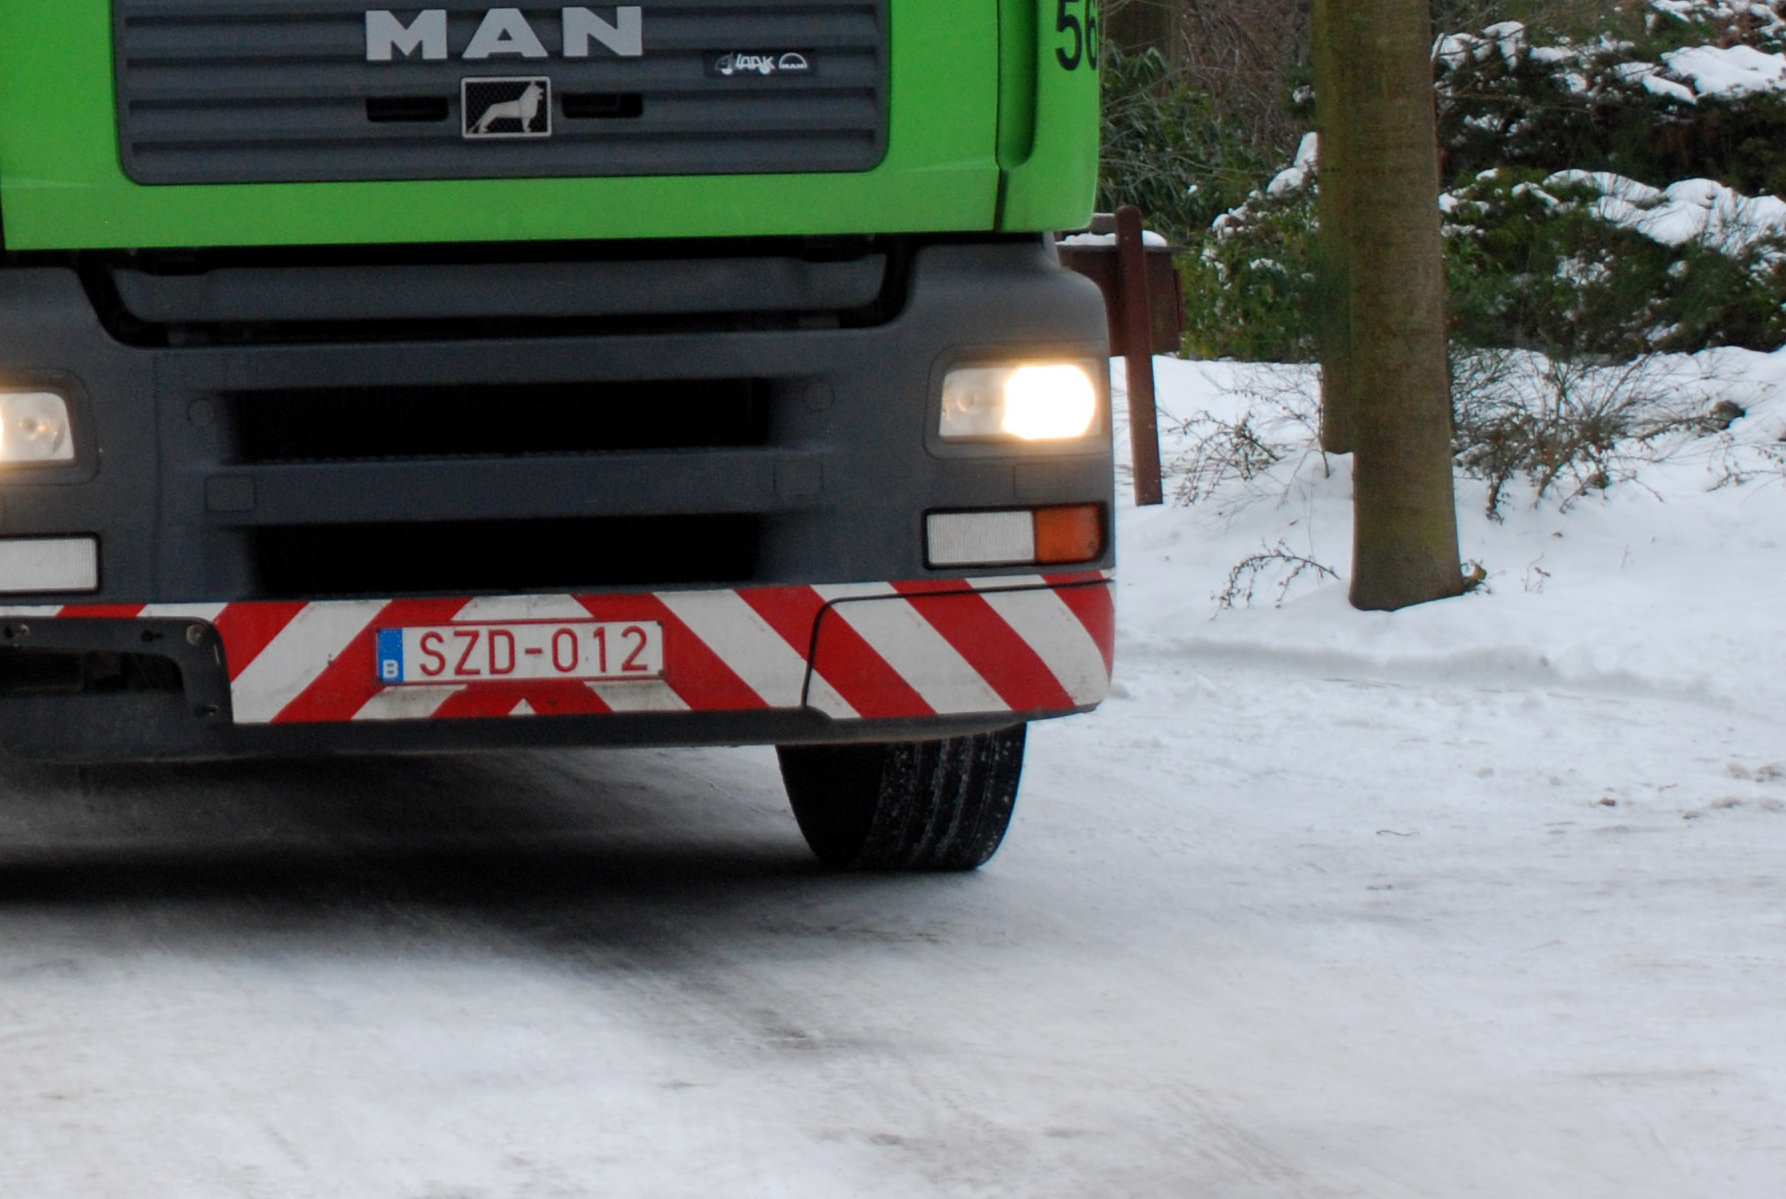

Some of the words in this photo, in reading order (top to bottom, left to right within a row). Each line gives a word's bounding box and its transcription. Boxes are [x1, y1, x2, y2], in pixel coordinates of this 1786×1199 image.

[365, 6, 642, 60] MAN
[383, 659, 399, 678] B
[418, 625, 648, 677] SZD-012
